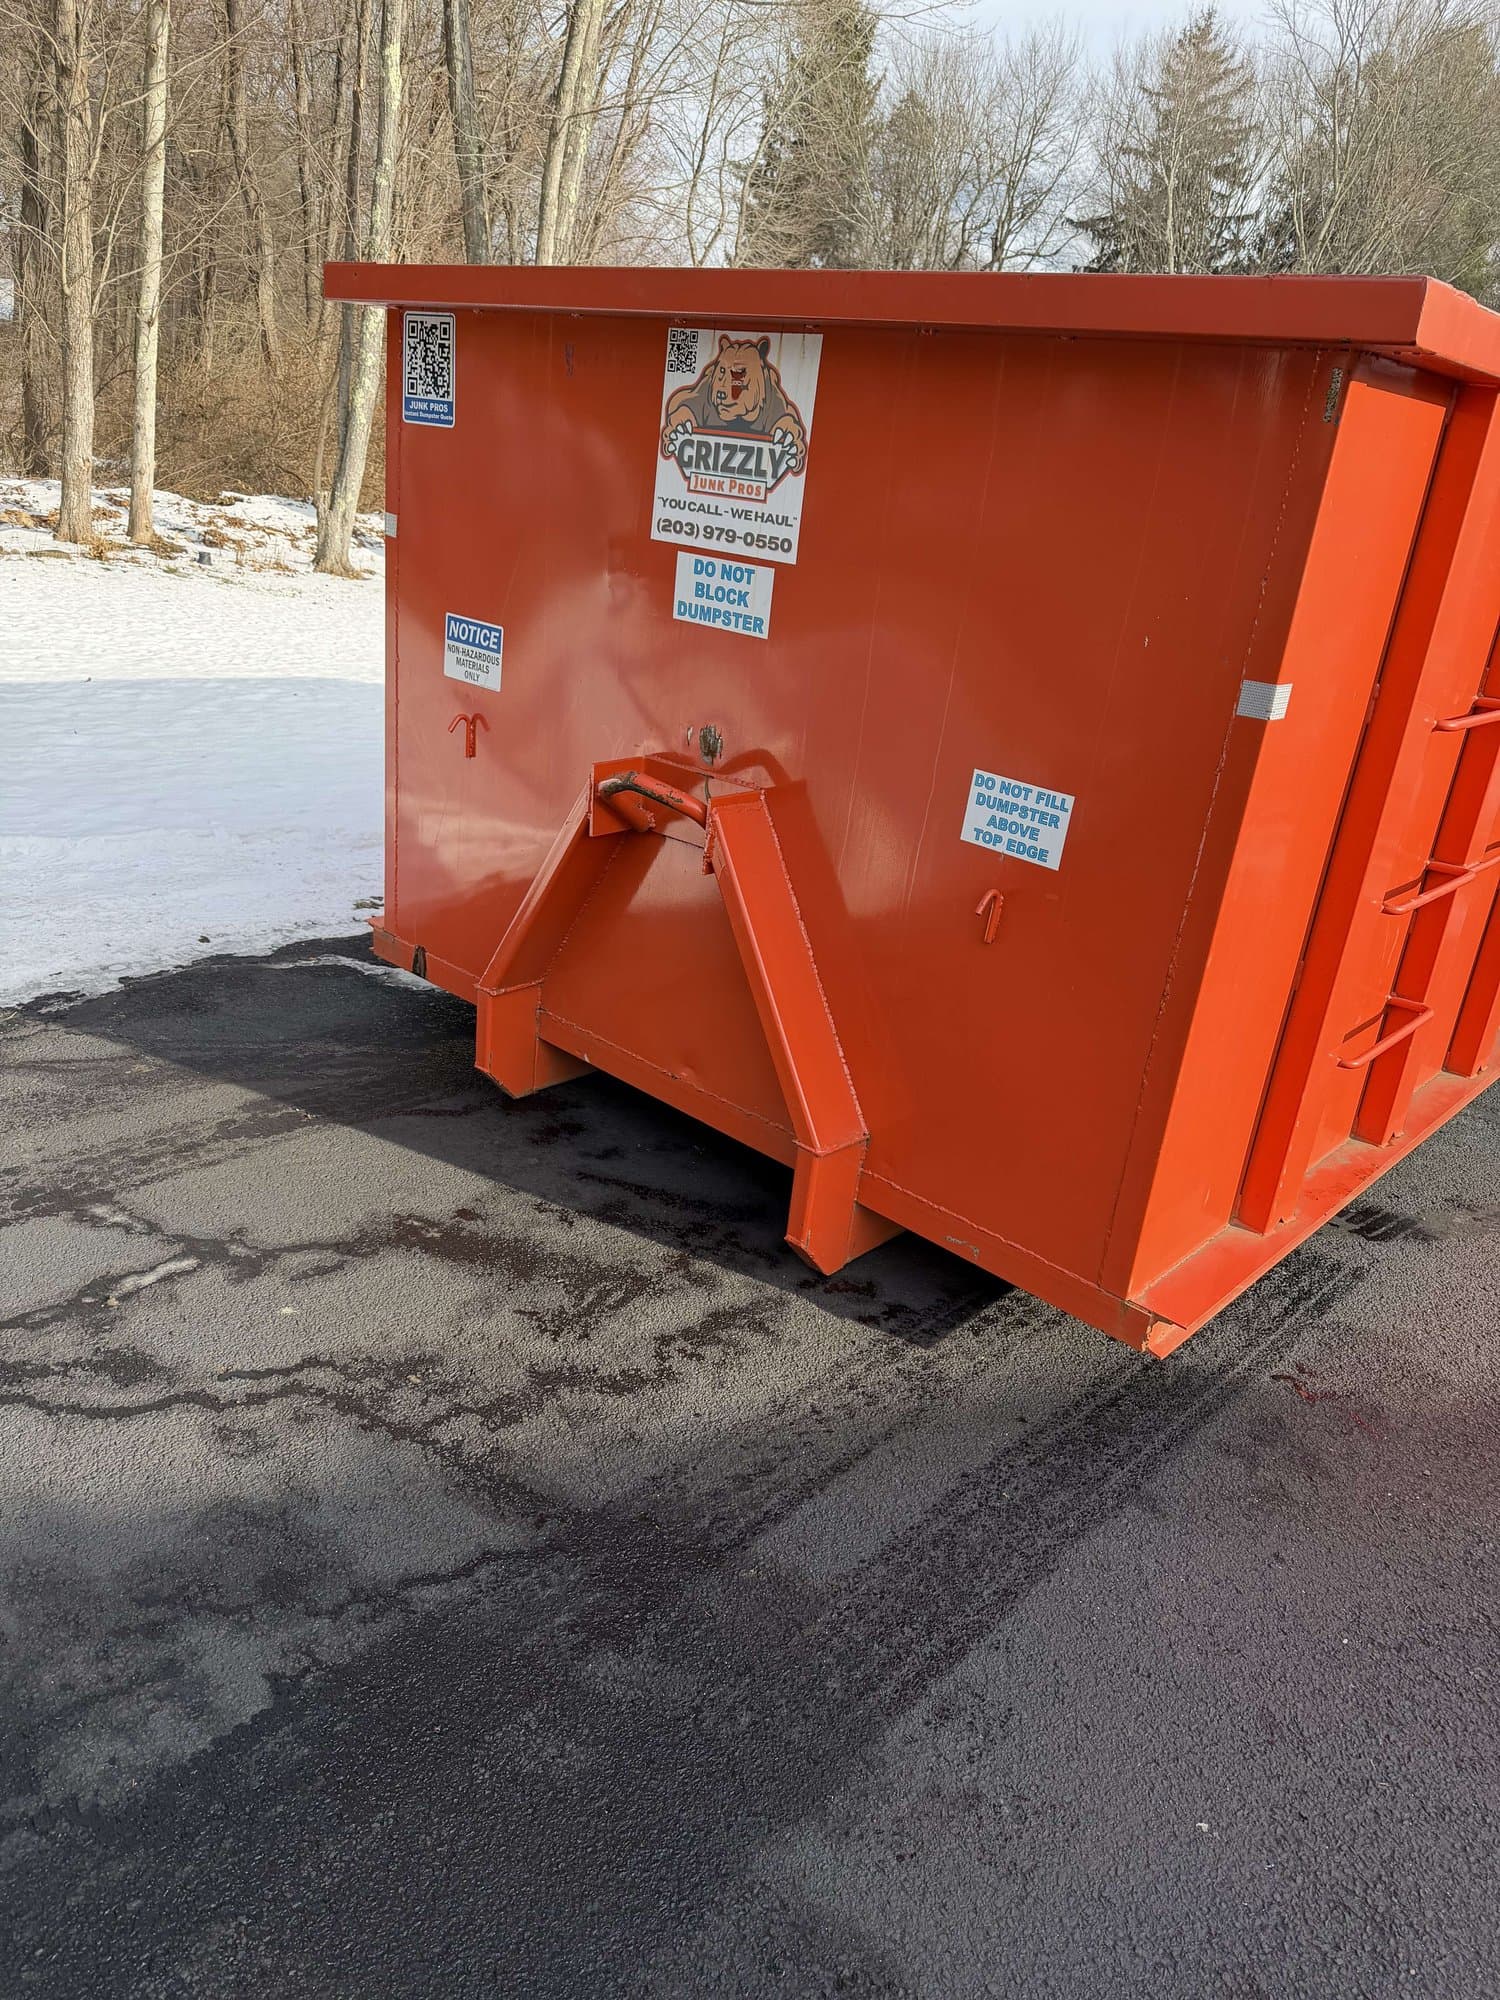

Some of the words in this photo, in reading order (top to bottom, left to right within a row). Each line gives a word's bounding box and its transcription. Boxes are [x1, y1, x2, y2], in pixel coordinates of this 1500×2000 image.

[409, 400, 429, 411] JUNK
[429, 402, 449, 413] PROS
[677, 438, 789, 480] GRIZZLY
[693, 475, 725, 492] JUNK
[728, 479, 762, 497] PROS
[656, 517, 700, 540] (203)
[702, 525, 793, 554] 979-0550
[693, 558, 717, 578] DO
[720, 563, 756, 586] NOT
[694, 581, 750, 608] BLOCK
[677, 600, 765, 635] DUMPSTER
[448, 620, 500, 650] NOTICE
[447, 643, 501, 666] NON-HAZARDOUS
[455, 656, 490, 675] MATERIALS
[464, 670, 480, 683] ONLY
[974, 773, 996, 791] DO
[999, 780, 1033, 801] NOT
[1035, 791, 1069, 813] FILL
[975, 792, 1061, 830] DUMPSTER
[986, 814, 1041, 842] ABOVE
[973, 827, 1004, 847] TOP
[1005, 838, 1050, 864] EDGE
